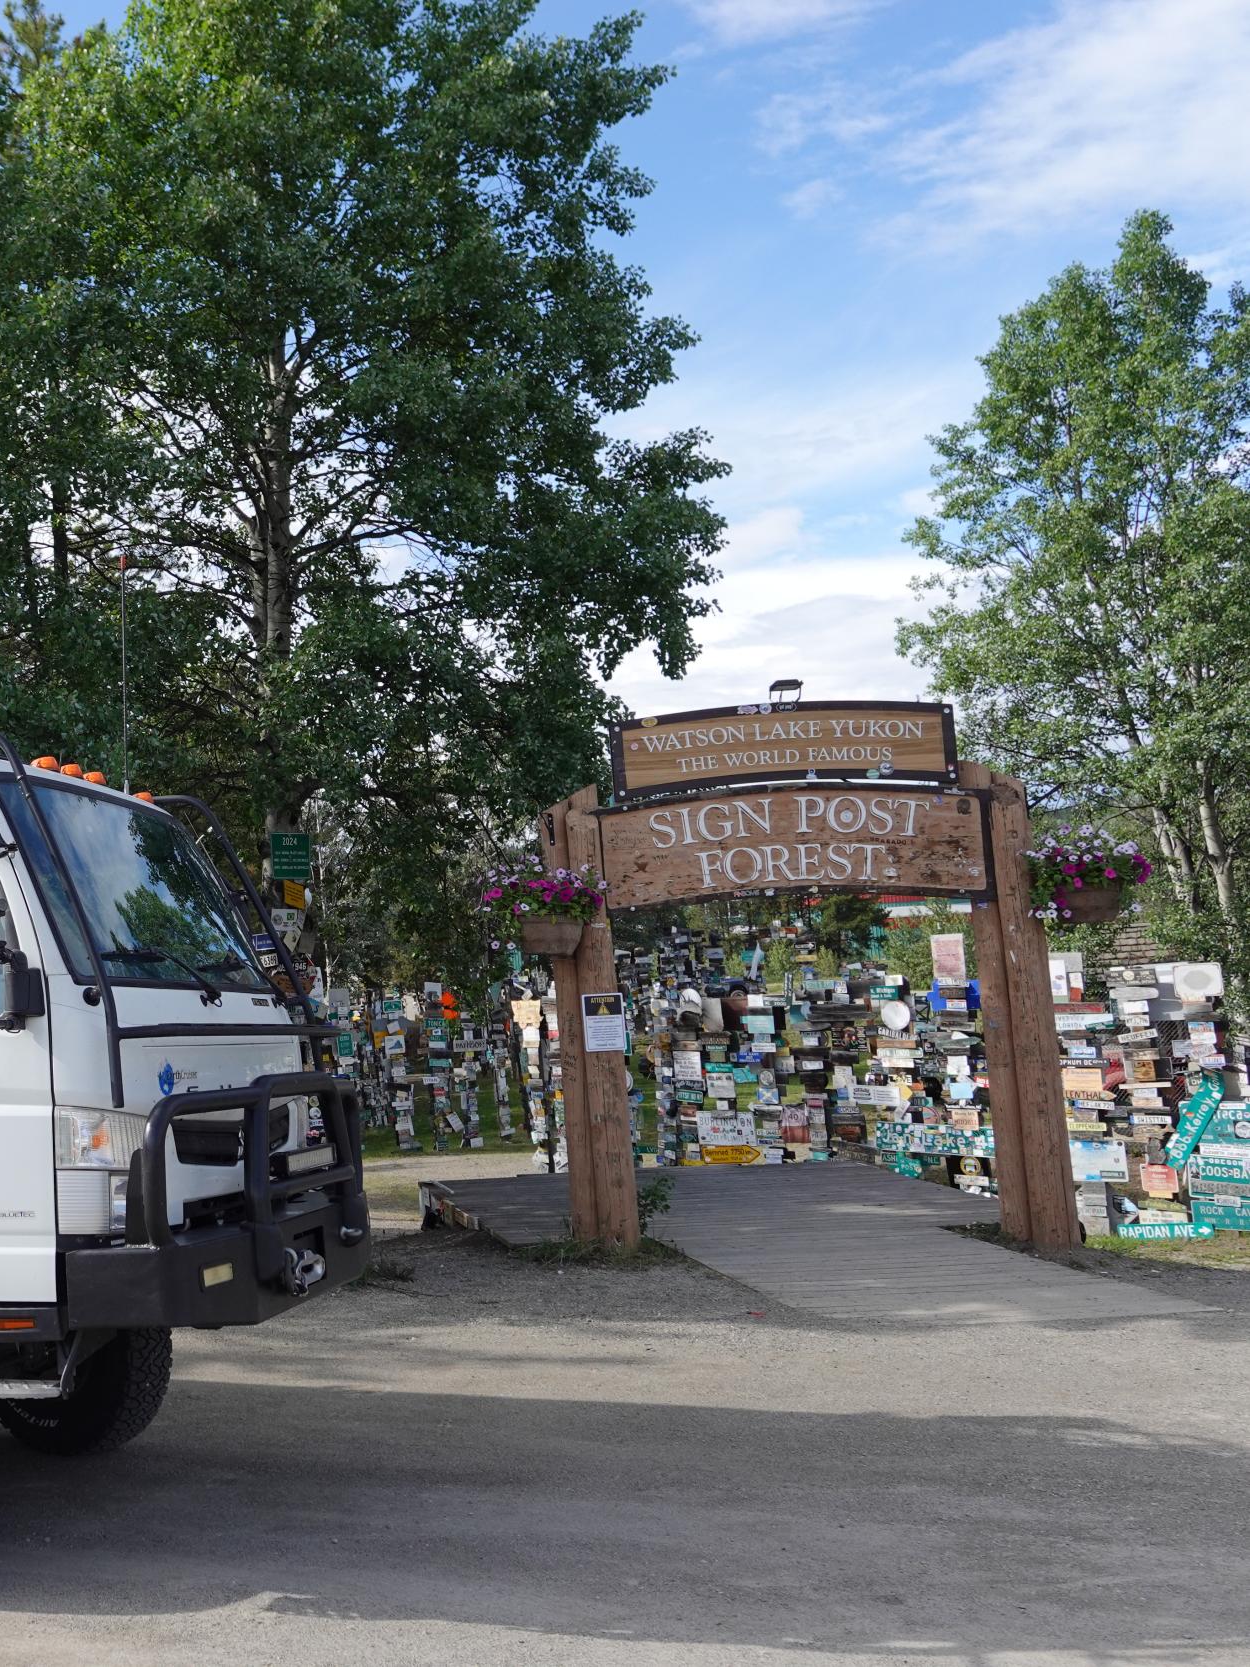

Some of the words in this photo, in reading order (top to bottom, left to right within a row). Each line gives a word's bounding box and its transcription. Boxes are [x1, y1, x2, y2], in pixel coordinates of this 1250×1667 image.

[642, 723, 746, 753] WATSON
[753, 720, 821, 742] LAKE
[829, 719, 924, 739] YUKON
[676, 754, 718, 773] THE
[723, 748, 800, 769] WORLD
[807, 746, 893, 763] FAMOUS
[649, 798, 772, 849] SIGN
[793, 795, 930, 837] POST
[695, 843, 886, 889] FOREST
[590, 996, 615, 1004] ATTENTION
[700, 1117, 752, 1127] BURLINGTON
[1199, 1165, 1228, 1177] COOS
[1200, 1205, 1224, 1215] ROCK
[1120, 1225, 1171, 1239] RAPIDAN
[1174, 1224, 1196, 1238] AVE
